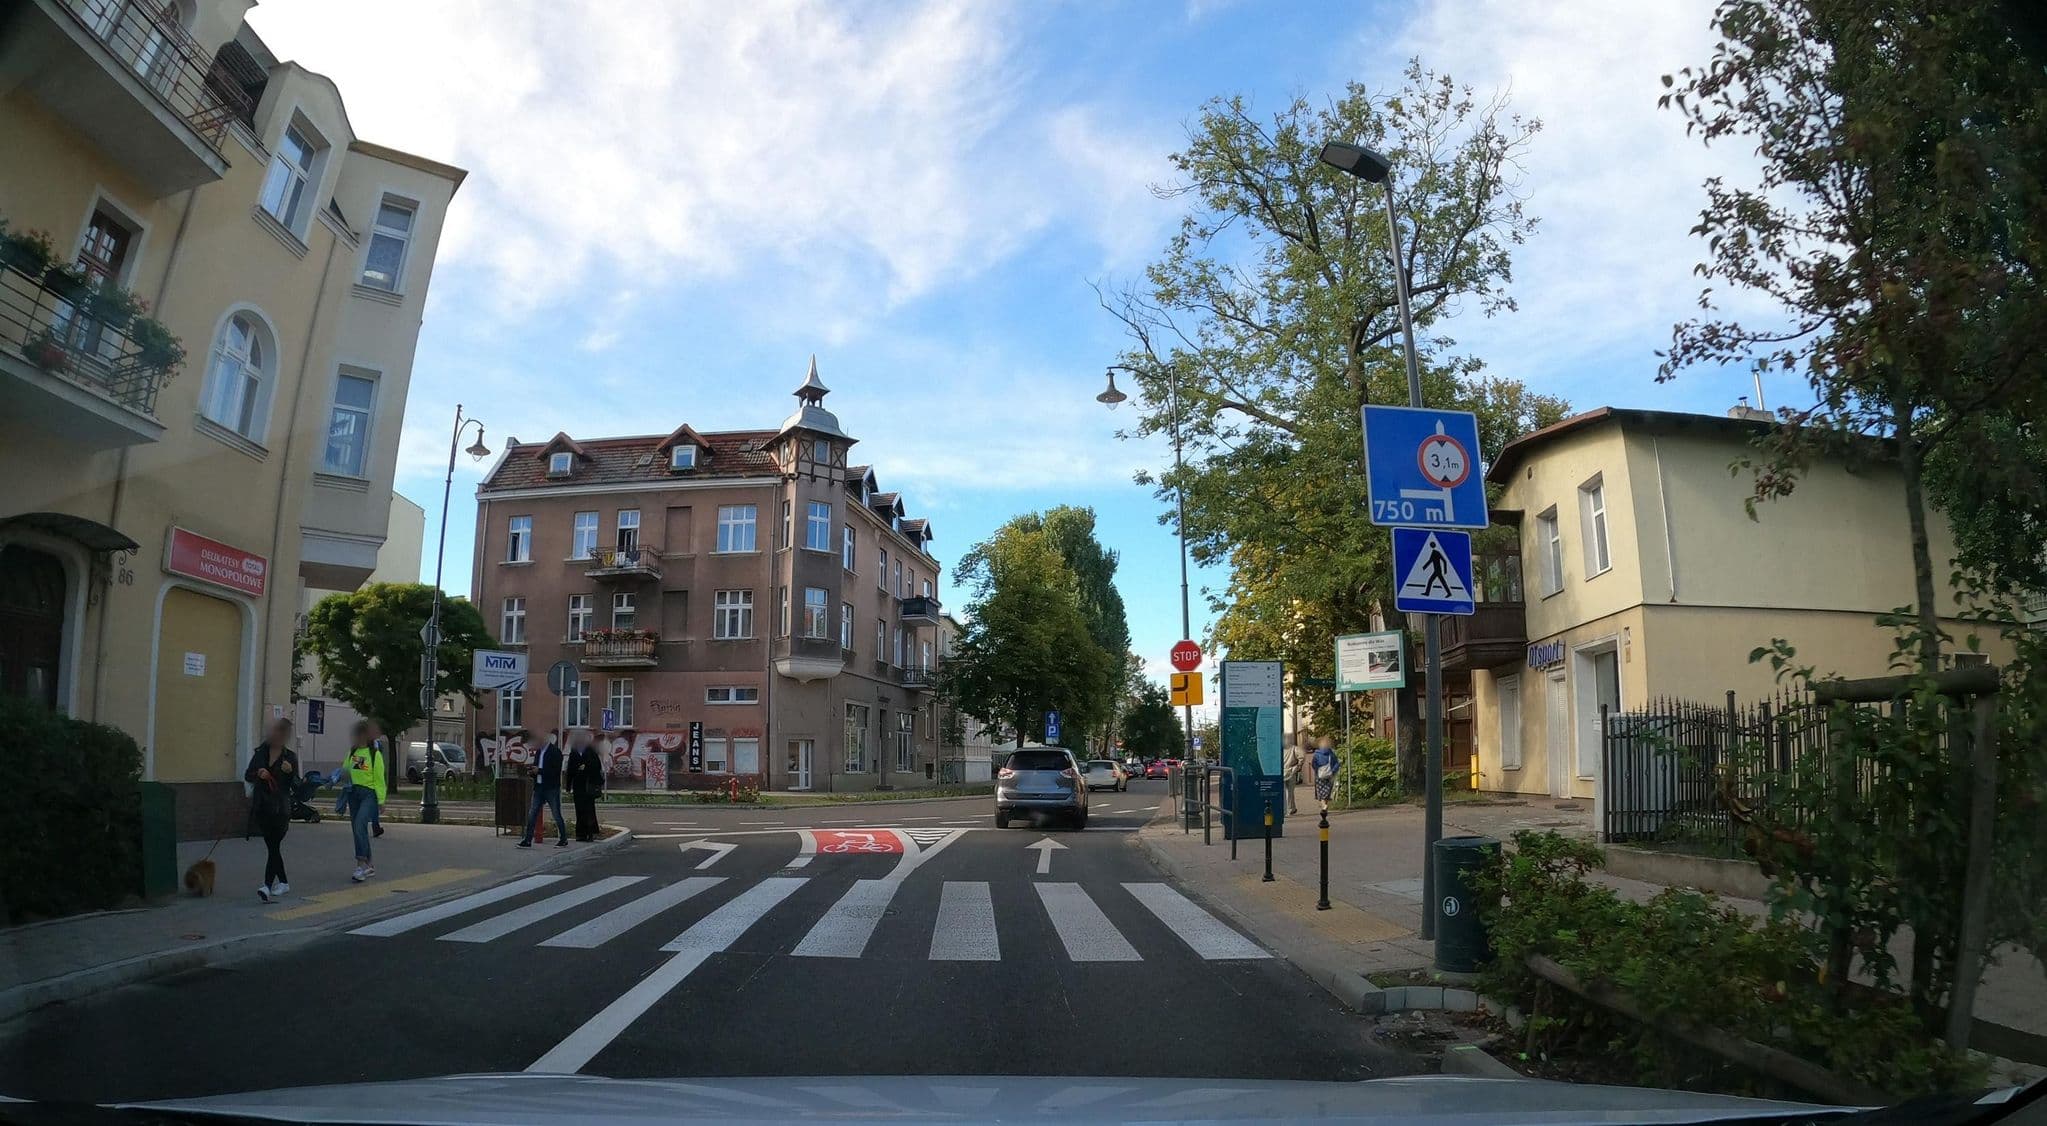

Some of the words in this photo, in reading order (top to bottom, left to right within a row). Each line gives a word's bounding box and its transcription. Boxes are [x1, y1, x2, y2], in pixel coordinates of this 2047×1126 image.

[1374, 500, 1415, 521] 750
[1425, 507, 1444, 522] m
[201, 550, 240, 568] DELIKATESY
[118, 568, 134, 586] 86
[200, 561, 263, 589] MONOPOLOWE
[485, 655, 516, 669] MTM
[1173, 650, 1199, 662] STOP
[1048, 725, 1057, 737] P
[692, 722, 700, 765] JEANS
